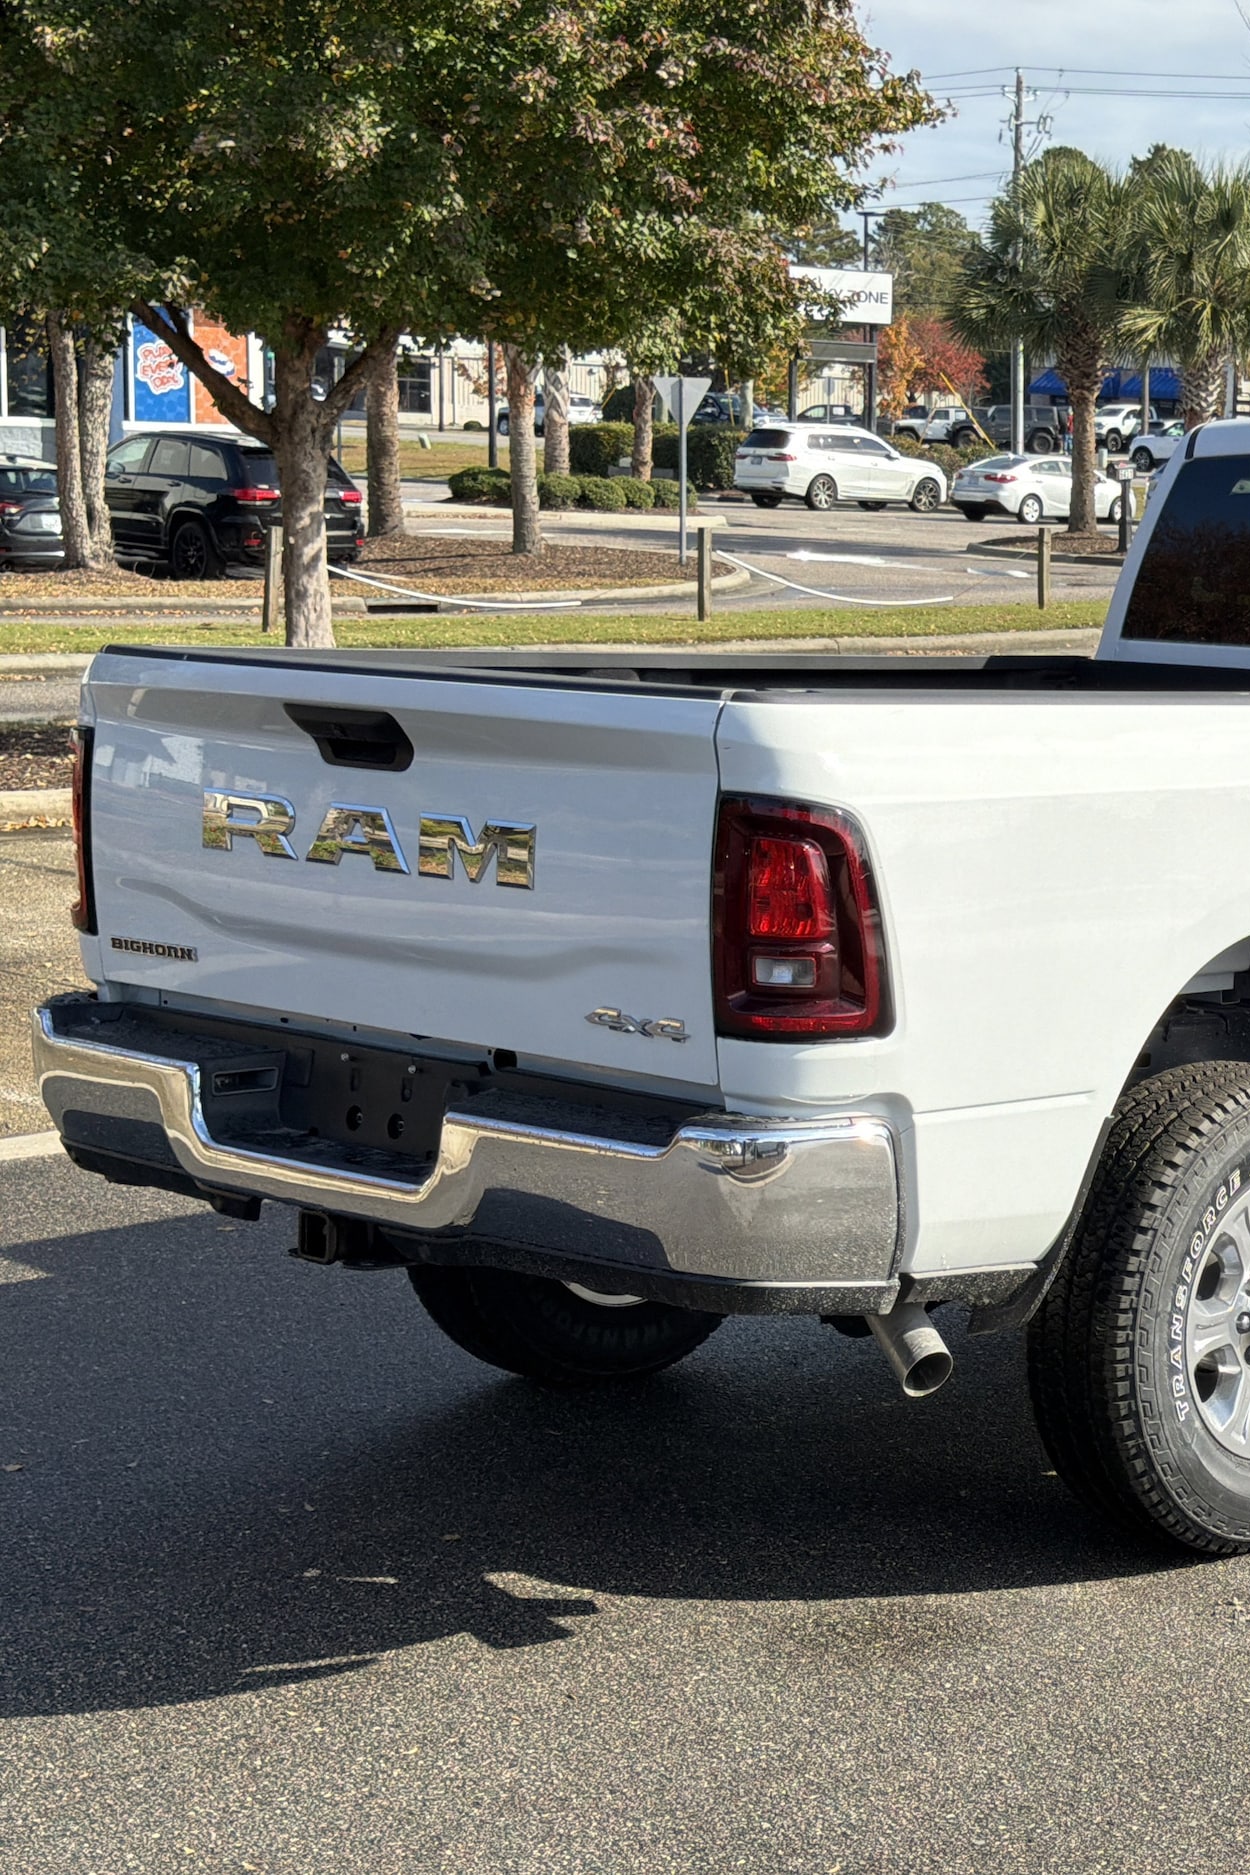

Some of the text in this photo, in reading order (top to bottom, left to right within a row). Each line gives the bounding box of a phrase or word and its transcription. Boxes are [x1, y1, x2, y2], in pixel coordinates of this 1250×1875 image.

[142, 343, 176, 360] PLA
[202, 786, 537, 891] RAM
[110, 937, 197, 962] BIGHORN
[1170, 1168, 1242, 1423] TRANSFORCE
